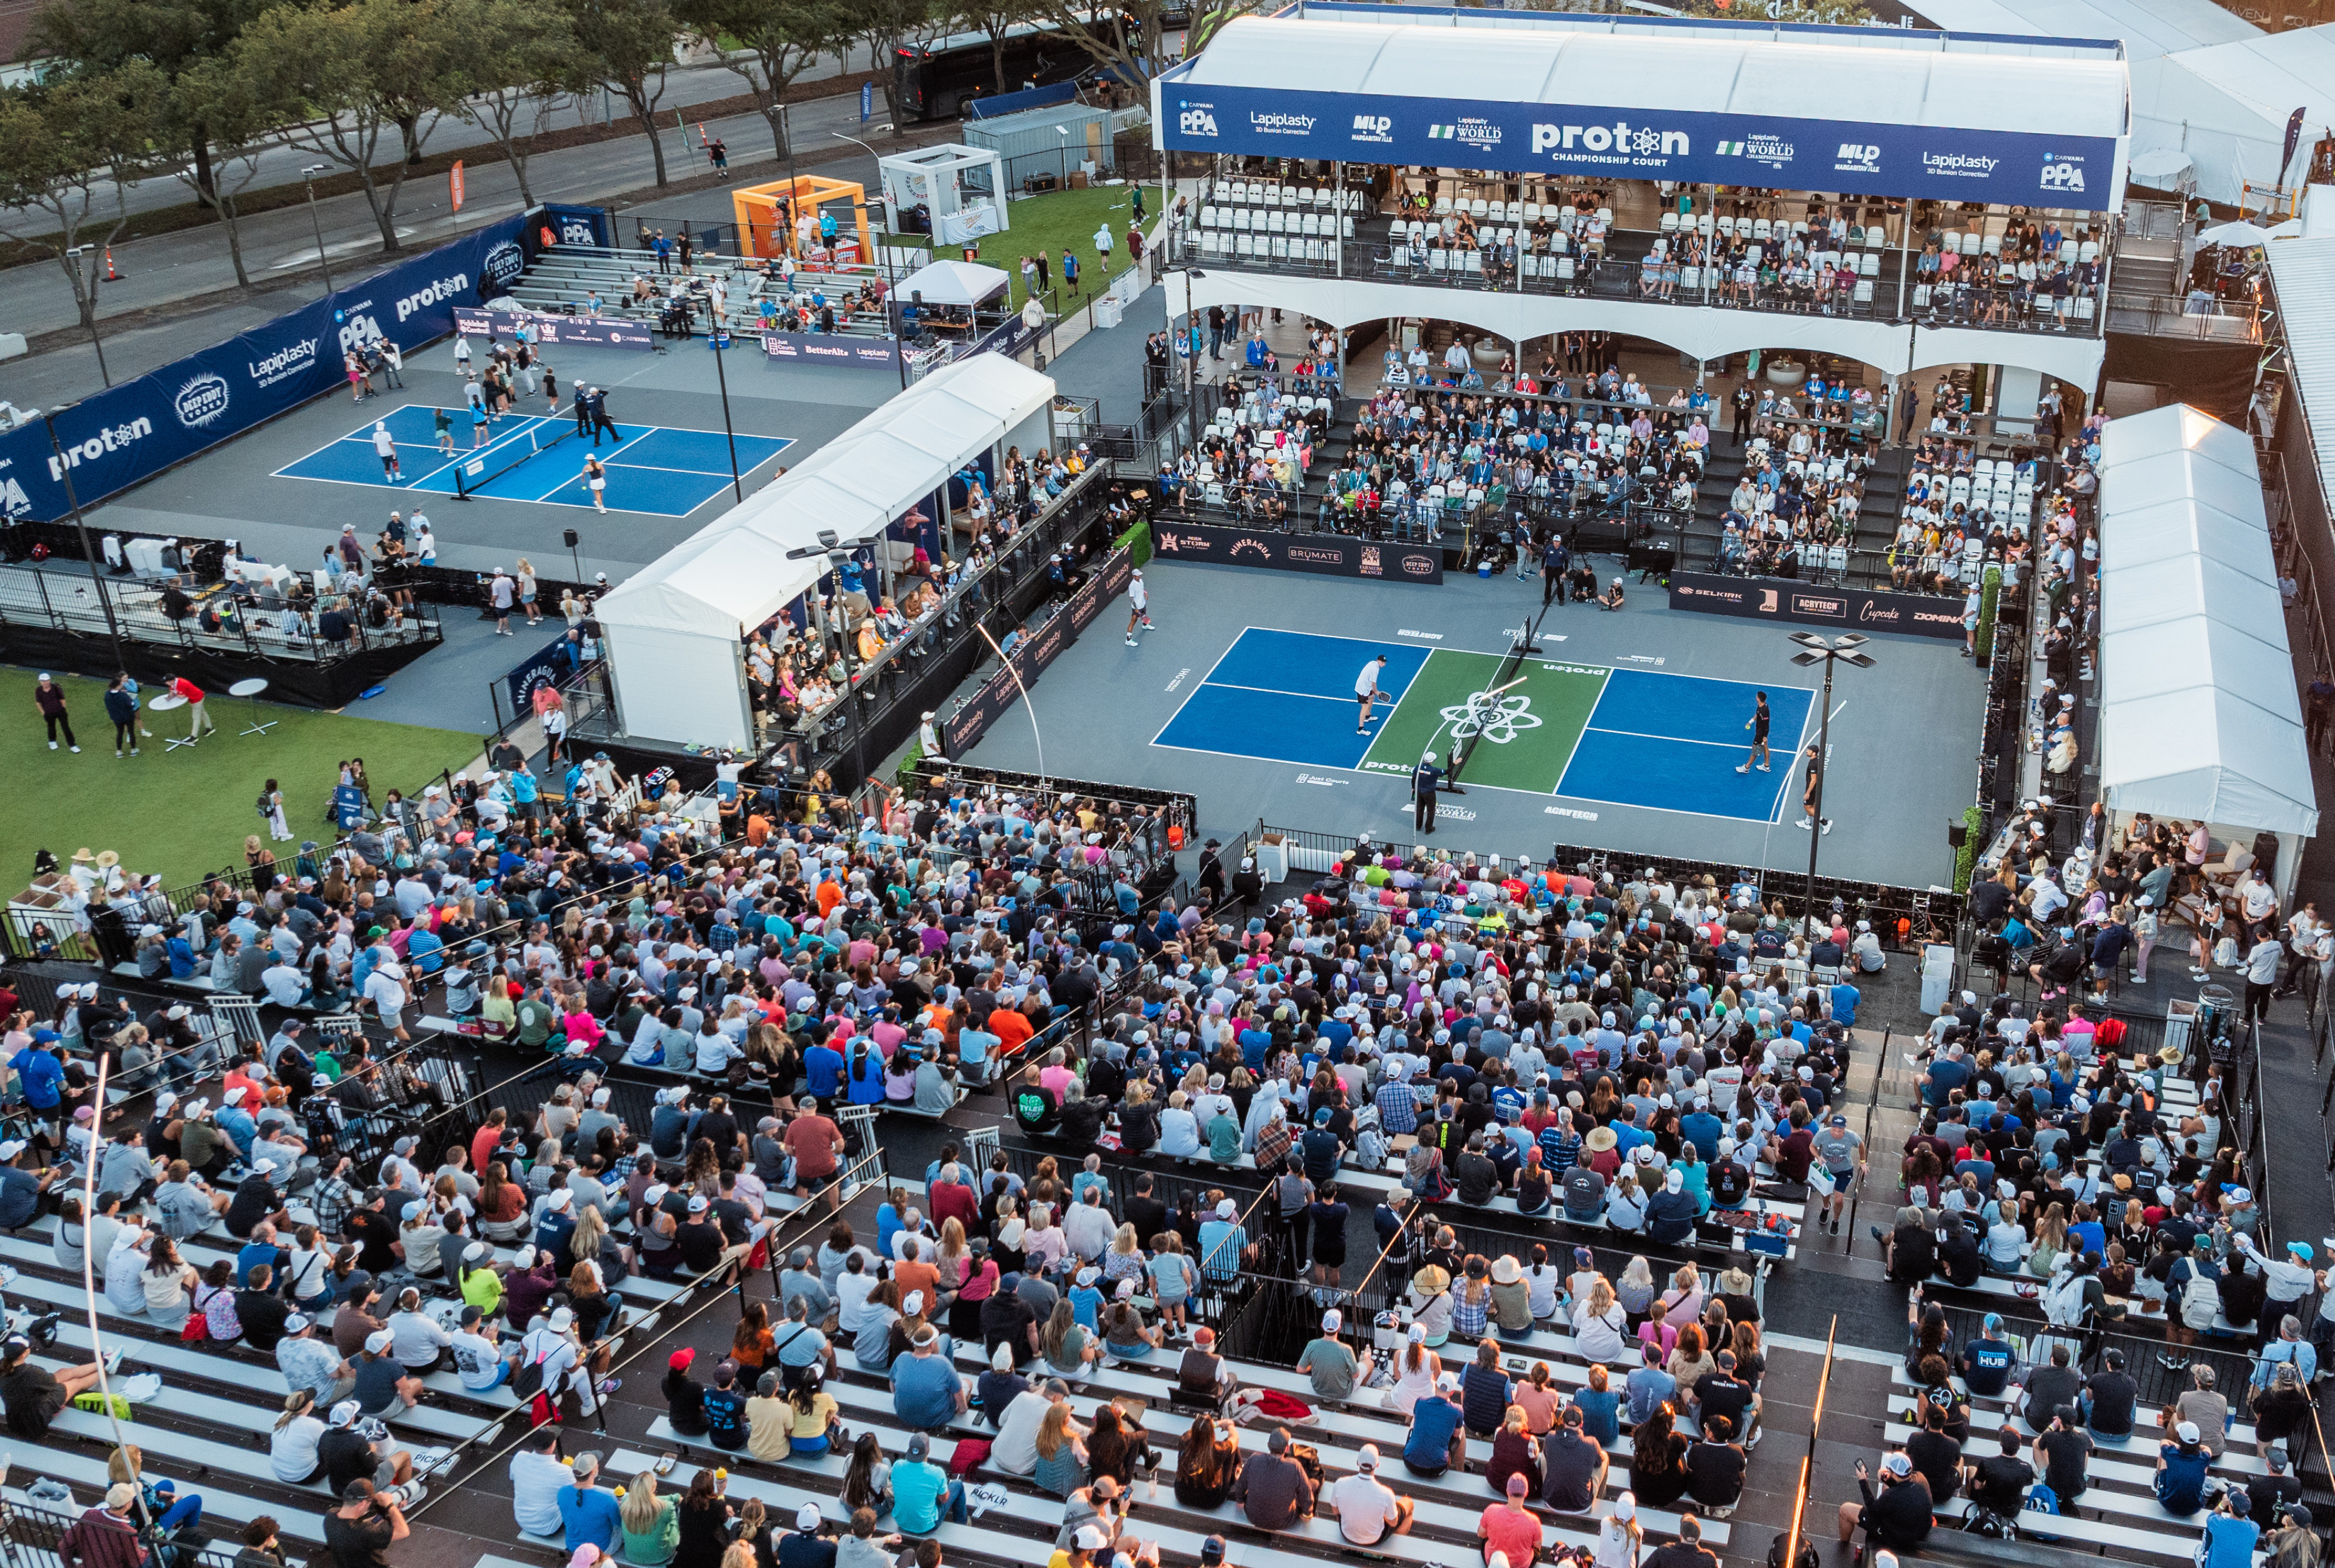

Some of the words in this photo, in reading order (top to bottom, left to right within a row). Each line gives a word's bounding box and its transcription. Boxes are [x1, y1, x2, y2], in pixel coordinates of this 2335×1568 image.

[1180, 109, 1218, 132] PPA
[1251, 110, 1315, 130] Lapiplasty
[1353, 115, 1391, 134] MLP
[1457, 116, 1488, 126] Lapiplasty
[1283, 128, 1310, 136] Correction
[1457, 128, 1502, 140] WORLD
[1748, 133, 1780, 142] Lapiplasty
[1746, 153, 1793, 162] CHAMPIONSHIPS
[1747, 144, 1794, 157] WORLD
[1837, 144, 1880, 164] MLP
[1552, 152, 1630, 165] CHAMPIONSHIP
[1632, 157, 1668, 167] COURT
[1923, 151, 1998, 172] Lapiplasty
[2054, 154, 2084, 162] CARVANA
[1936, 168, 1957, 176] Bunion
[1958, 169, 1990, 179] Correction
[2040, 163, 2085, 187] PPA
[563, 224, 595, 243] PPA
[344, 299, 373, 317] CARVANA
[338, 314, 383, 356] PPA
[497, 325, 514, 333] IHG
[622, 335, 651, 343] CARVANA
[777, 344, 796, 352] Courts
[856, 348, 891, 358] Lapiplasty
[248, 338, 317, 379] Lapiplasty
[182, 394, 202, 413] DEEP
[202, 386, 222, 404] EDDY
[188, 399, 222, 418] VODKA
[12, 503, 32, 517] TOUR
[1229, 538, 1272, 560] MINERAGUA
[1695, 589, 1743, 599] SELKIRK
[1799, 599, 1838, 610] ACRYTECH
[1860, 600, 1900, 622] Cupcake
[1034, 629, 1061, 661] Lapiplasty
[1175, 668, 1191, 680] IHG
[517, 665, 556, 704] MINERAGUA
[953, 708, 984, 744] Lapiplasty
[1325, 777, 1349, 785] Courts
[1544, 806, 1599, 820] ACRYTECH
[1020, 1104, 1044, 1112] TYLER
[1979, 1357, 2006, 1366] HUB
[414, 1454, 452, 1466] PICKR
[970, 1488, 1008, 1506] PICKLR
